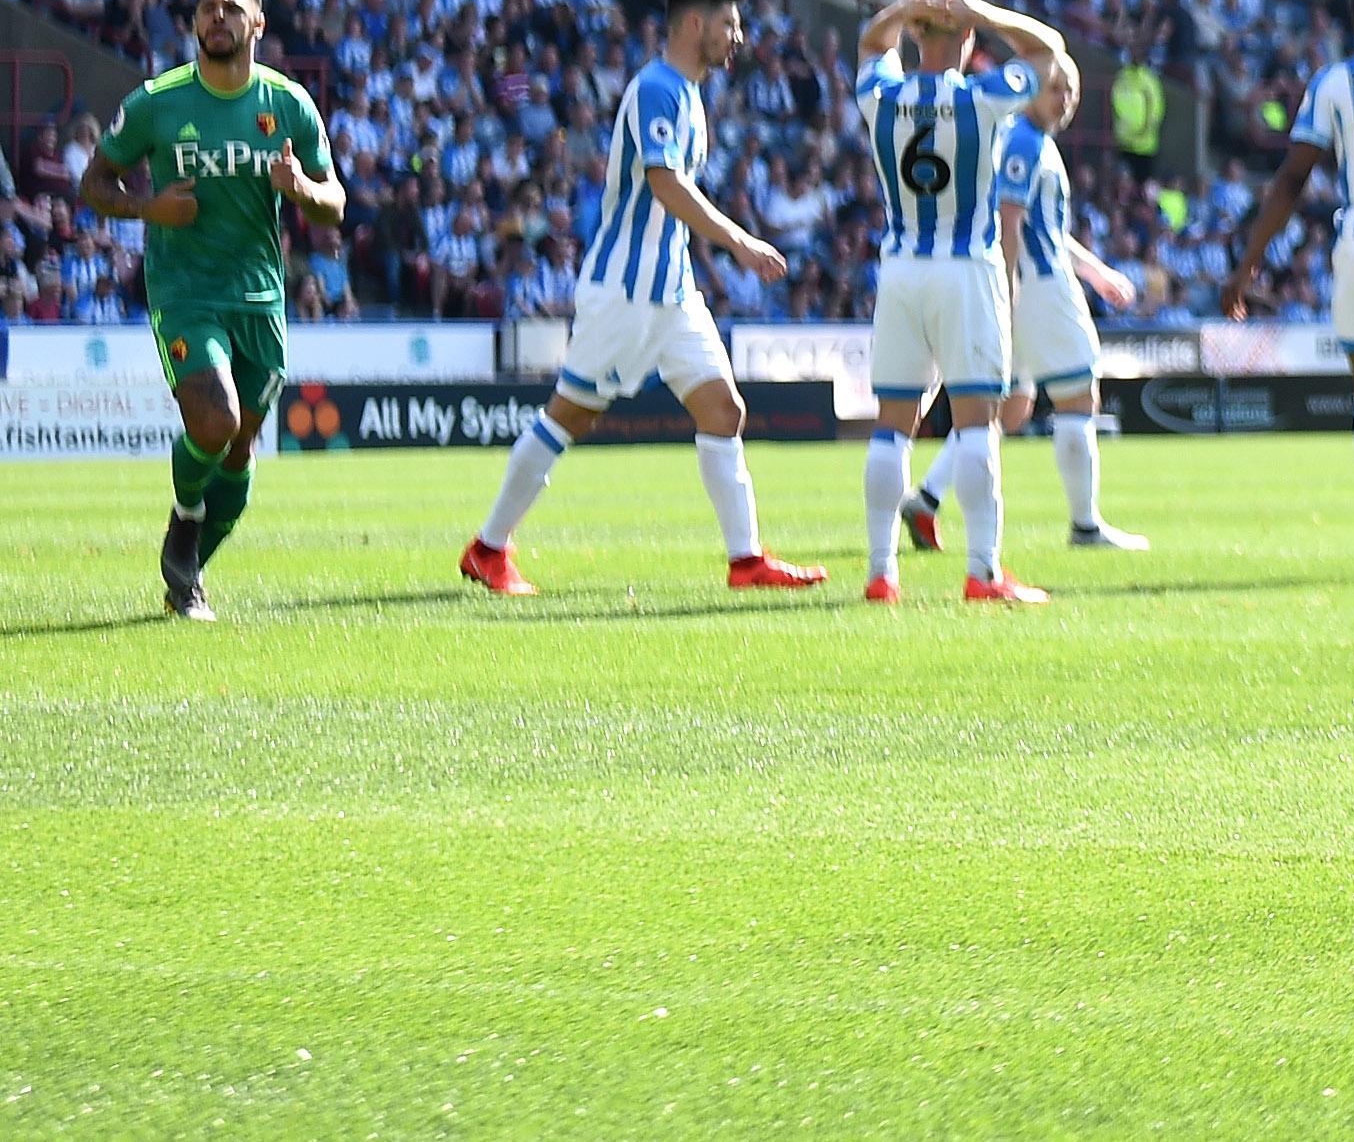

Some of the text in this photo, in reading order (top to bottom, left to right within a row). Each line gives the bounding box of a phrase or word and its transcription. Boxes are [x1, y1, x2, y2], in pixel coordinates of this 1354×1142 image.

[900, 125, 951, 195] 6
[359, 396, 402, 441] All
[407, 396, 456, 446] My
[460, 395, 543, 446] Syste
